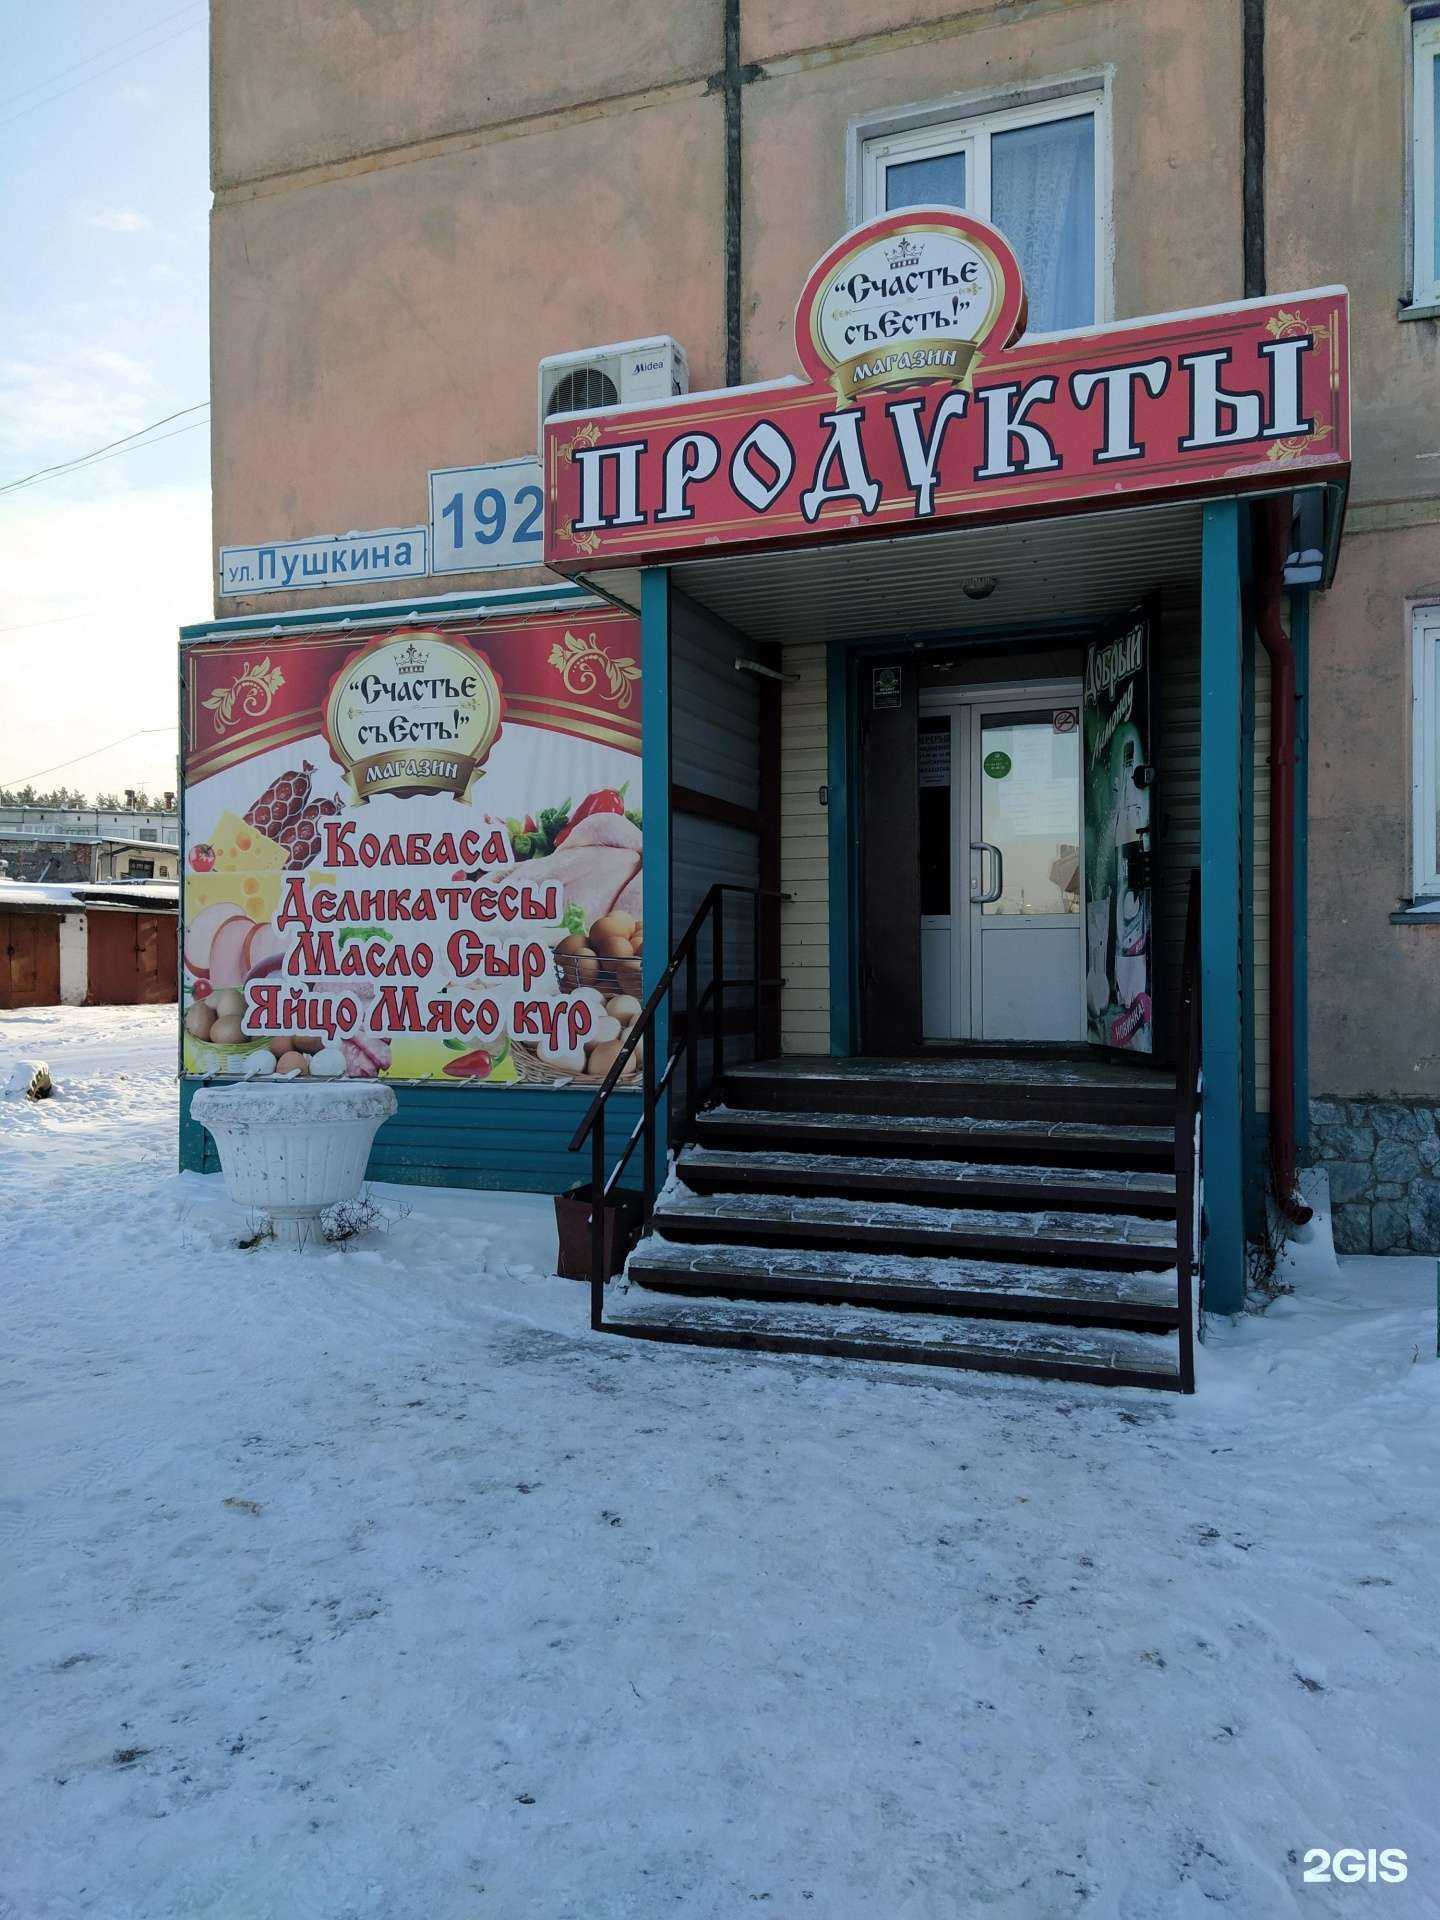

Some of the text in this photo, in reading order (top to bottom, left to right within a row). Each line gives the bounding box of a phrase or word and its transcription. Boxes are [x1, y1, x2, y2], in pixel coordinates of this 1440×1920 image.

[632, 358, 664, 375] Midea
[571, 335, 1317, 529] ПРОДУКТЫ
[441, 485, 544, 549] 192
[1084, 623, 1144, 707] Добрый
[322, 821, 509, 868] Колбаса
[276, 877, 557, 932] Деликатесы
[287, 929, 546, 991] Масло Сыр
[247, 984, 592, 1051] Яйцо Мясо кур
[1114, 1002, 1146, 1041] НОВИНКА!
